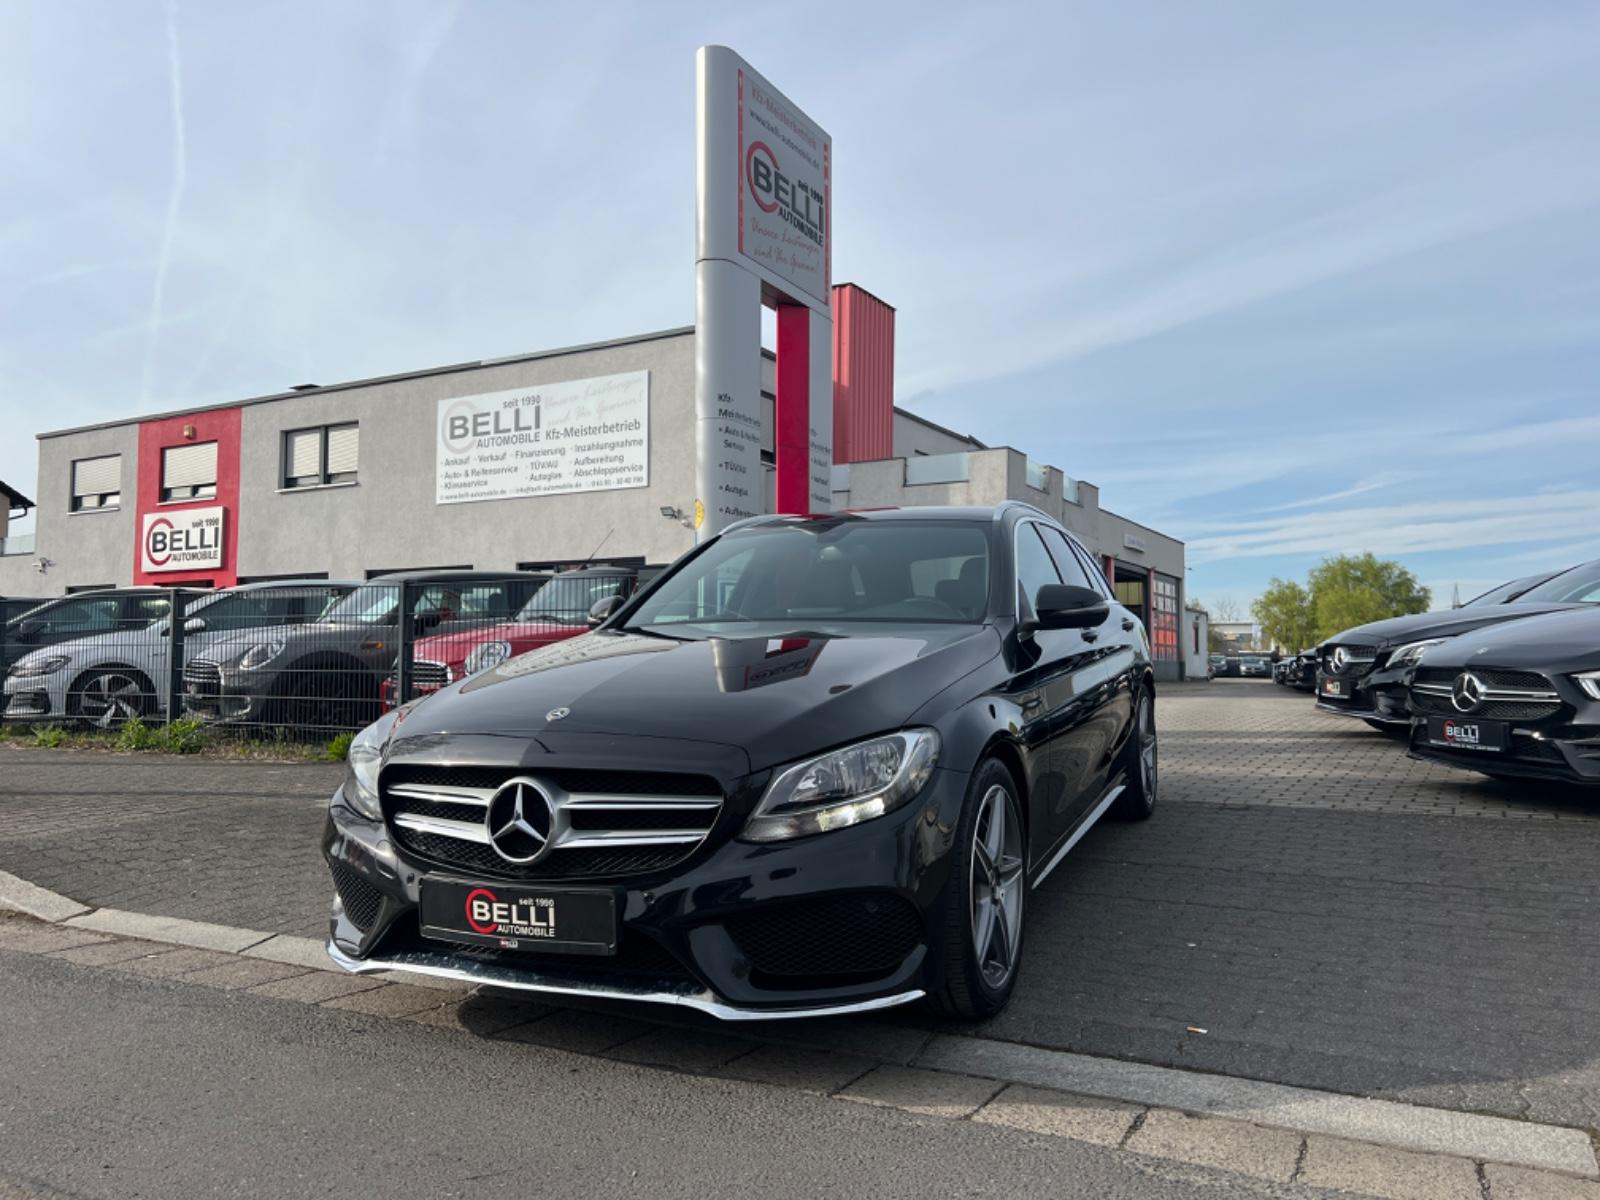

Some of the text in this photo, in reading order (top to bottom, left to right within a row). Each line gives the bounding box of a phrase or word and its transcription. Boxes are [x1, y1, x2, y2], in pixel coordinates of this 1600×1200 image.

[753, 156, 824, 234] BELLI
[778, 205, 824, 248] AUTOMOBILE
[502, 394, 541, 409] seit 1990
[449, 405, 541, 440] BELLI
[545, 418, 641, 440] Kfz-Meisterbetrieb
[476, 431, 541, 449] AUTOMOBILE
[514, 447, 566, 459] Finanzierung
[152, 527, 219, 552] BELLI
[172, 550, 218, 561] AUTOMOBILE
[518, 898, 534, 906] seit
[473, 900, 555, 927] BELLI
[497, 924, 555, 937] AUTOMOBILE
